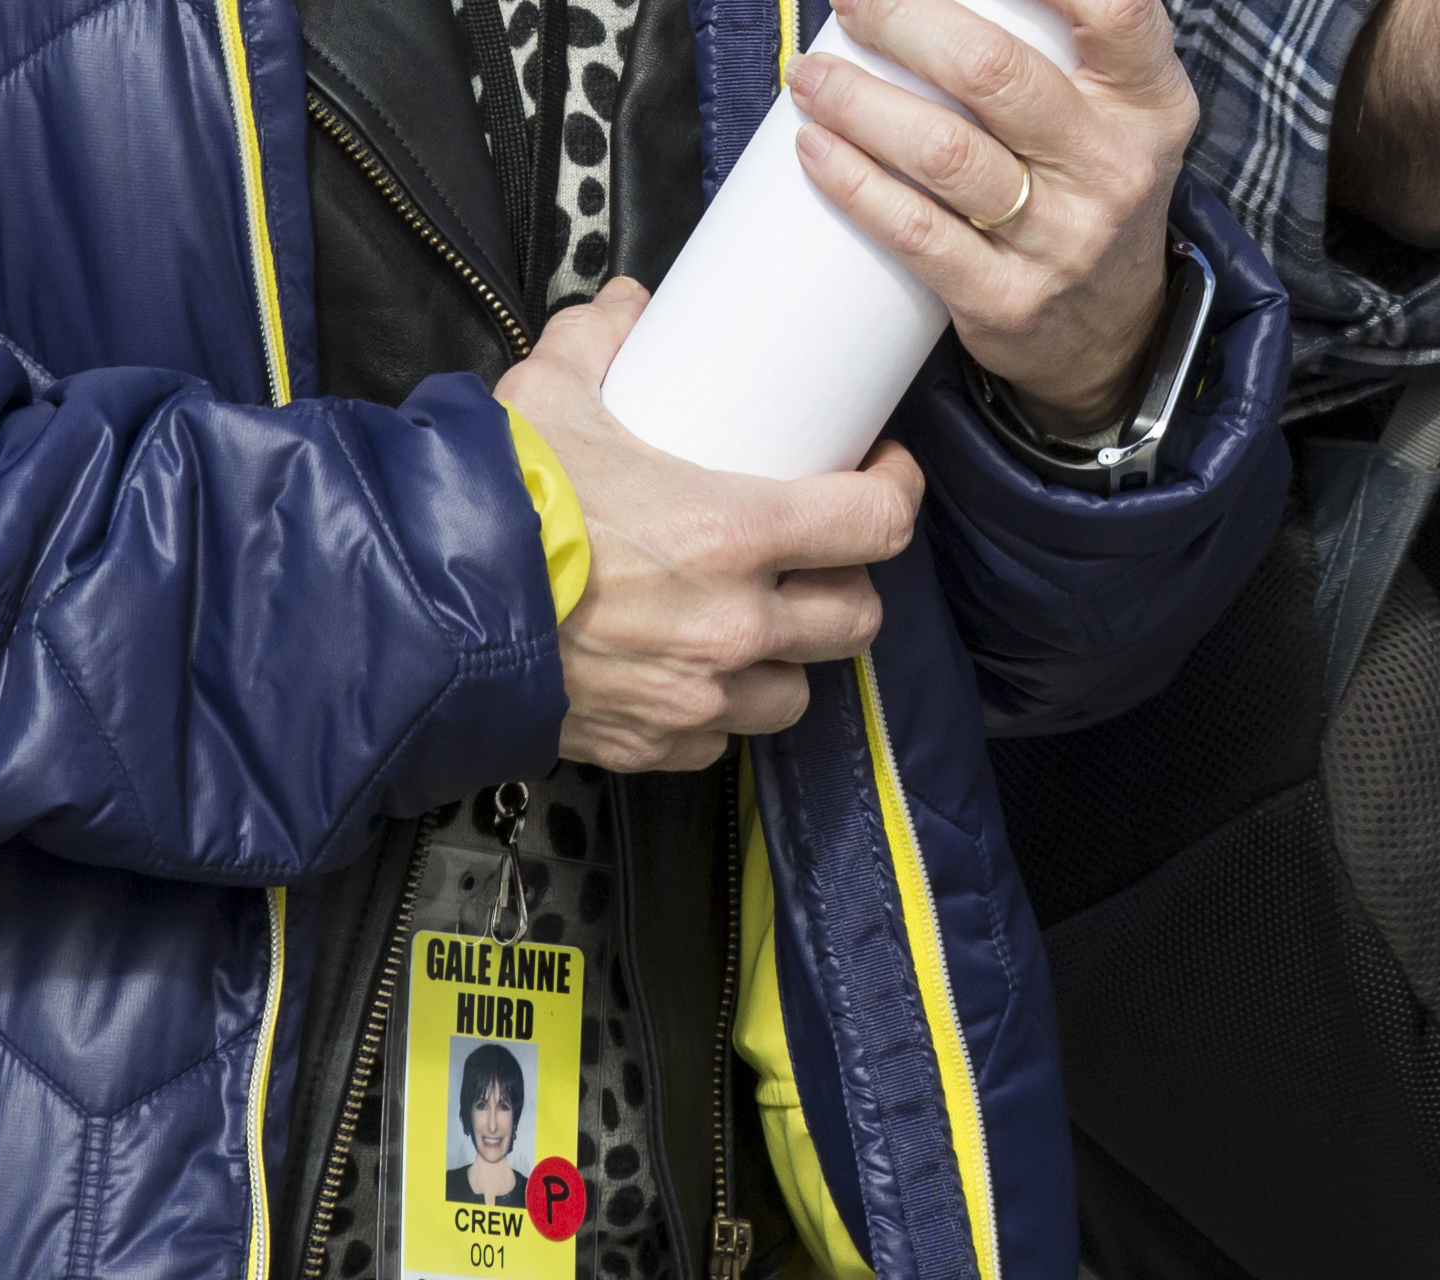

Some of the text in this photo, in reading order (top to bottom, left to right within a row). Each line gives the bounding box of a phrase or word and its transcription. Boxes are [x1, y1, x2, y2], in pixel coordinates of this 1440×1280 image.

[426, 938, 571, 994] GALE ANNE
[456, 992, 534, 1040] HURD
[455, 1208, 523, 1237] CREW
[542, 1175, 570, 1225] P
[471, 1243, 504, 1269] 001
